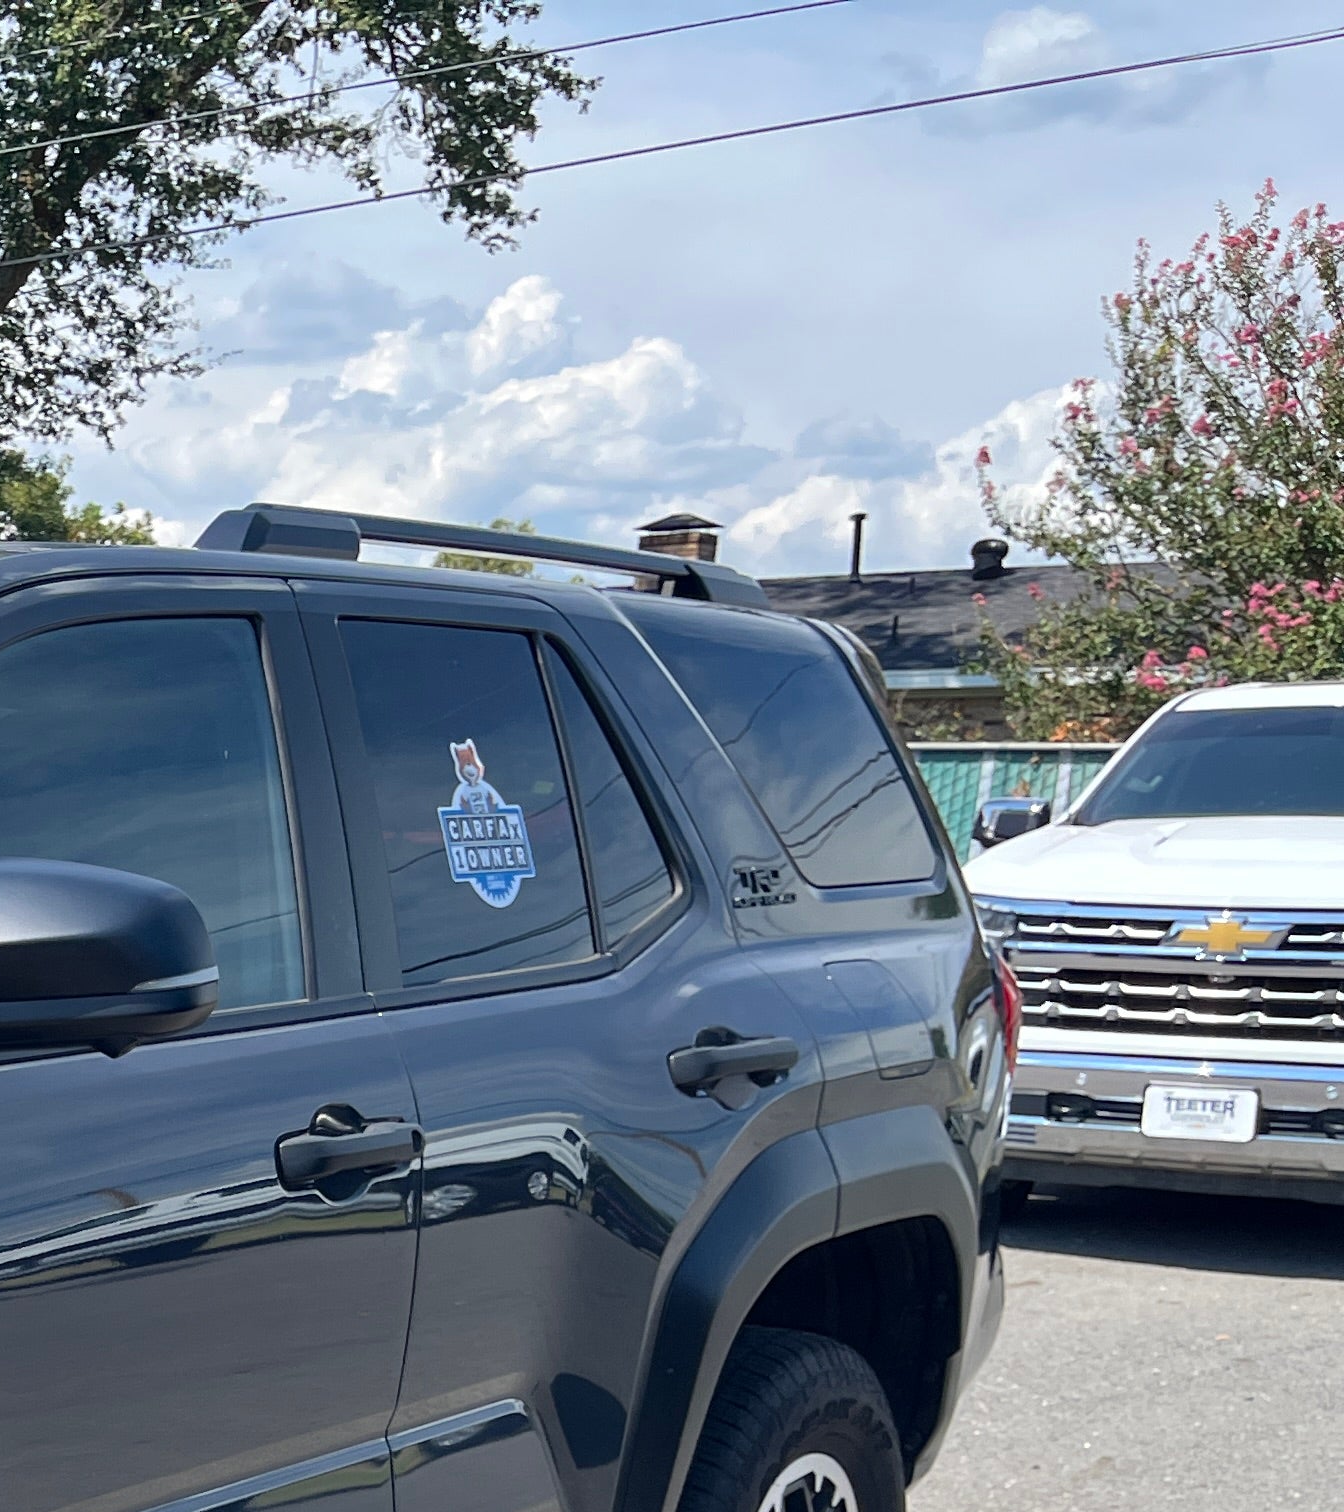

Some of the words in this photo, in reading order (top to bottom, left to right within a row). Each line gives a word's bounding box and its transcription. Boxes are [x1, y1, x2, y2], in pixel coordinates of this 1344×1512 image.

[448, 818, 523, 840] CARFAX
[455, 848, 465, 869] 1
[468, 846, 527, 868] OWNER
[1164, 1096, 1236, 1118] TEETER
